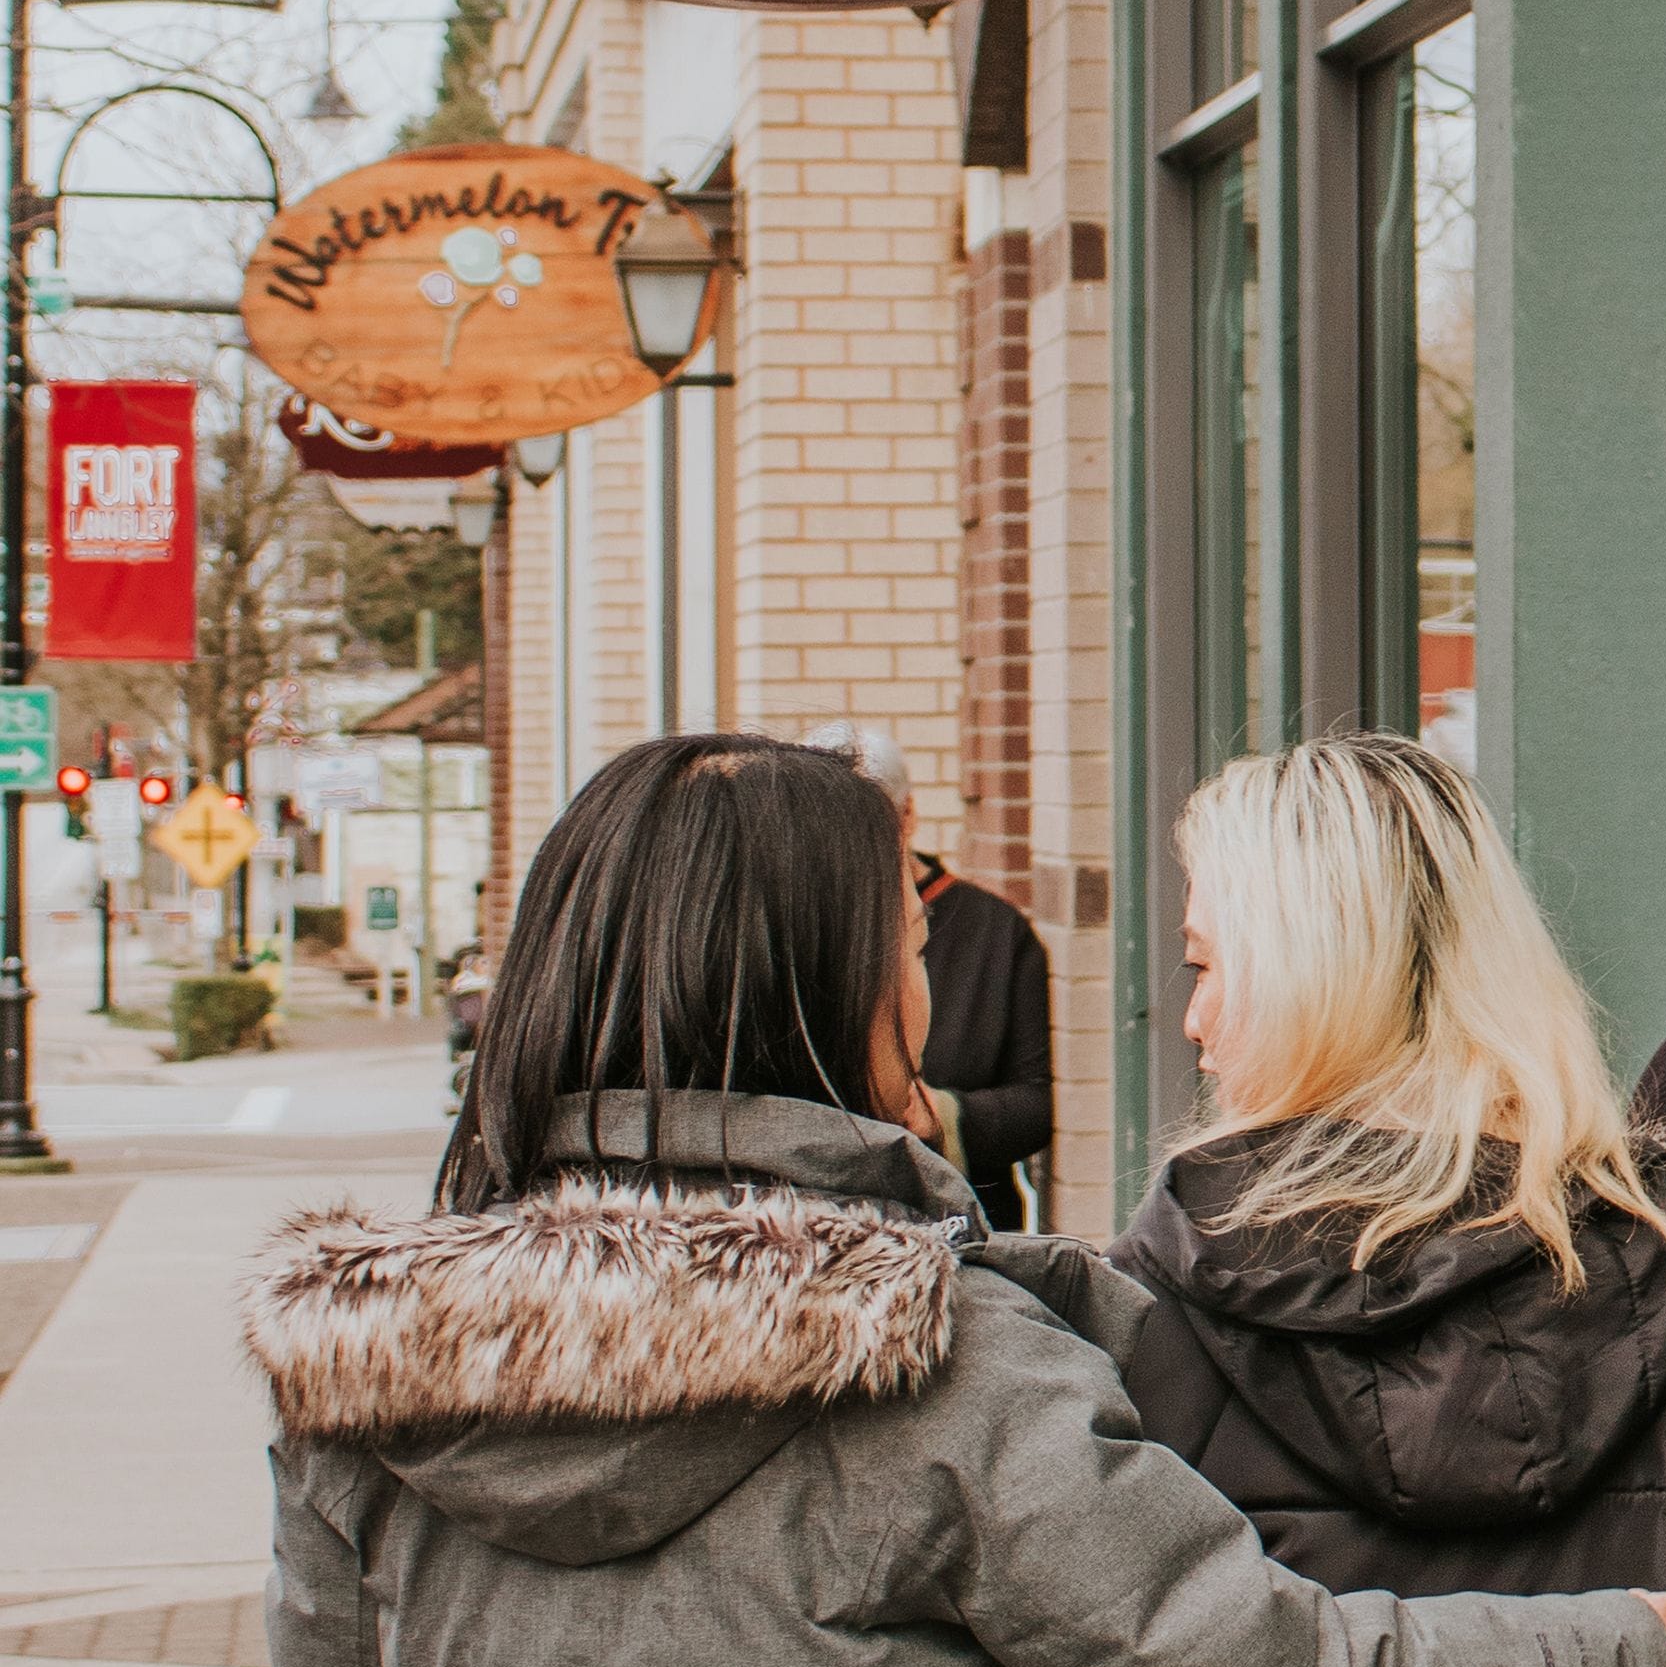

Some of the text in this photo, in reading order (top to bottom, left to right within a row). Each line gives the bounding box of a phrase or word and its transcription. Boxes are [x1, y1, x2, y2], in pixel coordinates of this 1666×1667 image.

[266, 172, 580, 311] Watermelon
[299, 337, 444, 414] BABY
[69, 447, 180, 507] FORT
[69, 509, 175, 542] LANGLEY
